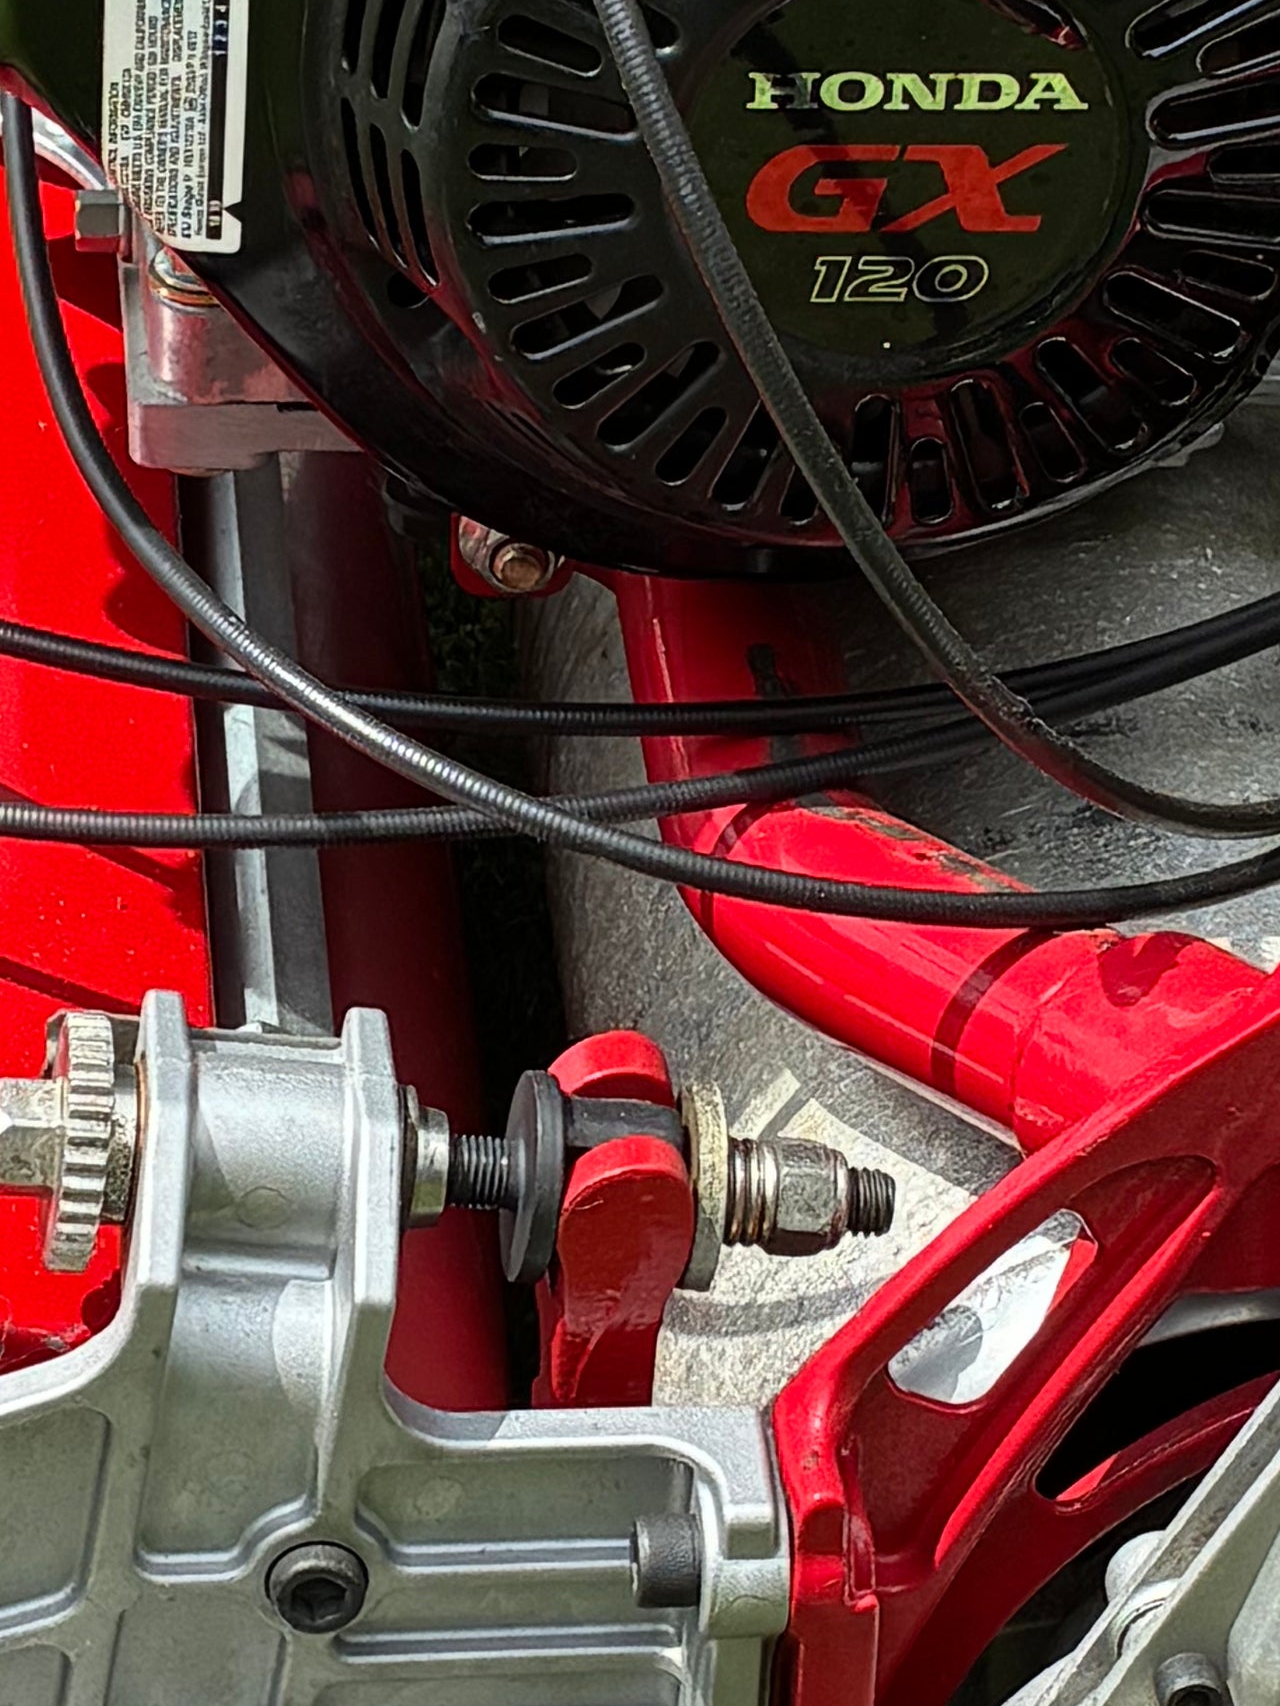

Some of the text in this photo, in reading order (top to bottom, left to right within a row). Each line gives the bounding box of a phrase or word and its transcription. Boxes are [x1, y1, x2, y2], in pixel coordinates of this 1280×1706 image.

[746, 71, 1089, 111] HONDA
[746, 143, 1070, 233] GX
[809, 255, 989, 303] 120
